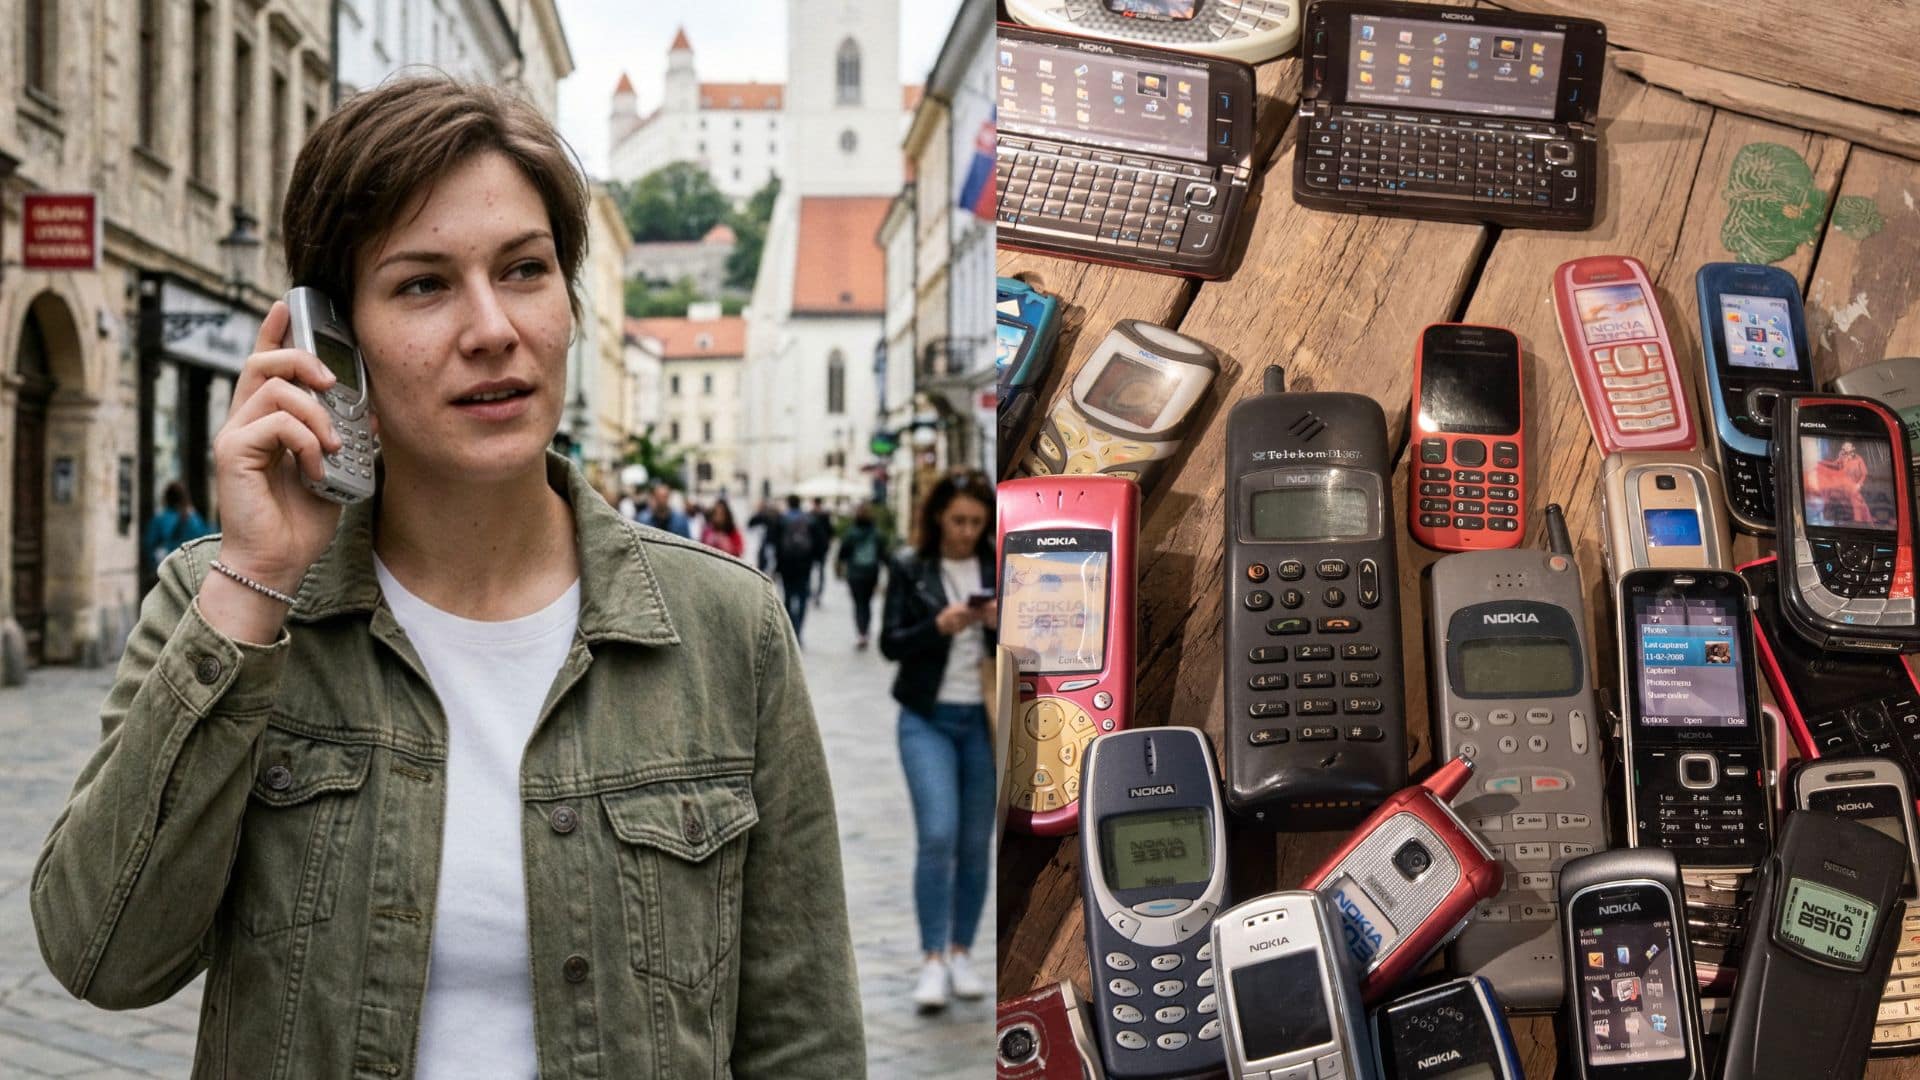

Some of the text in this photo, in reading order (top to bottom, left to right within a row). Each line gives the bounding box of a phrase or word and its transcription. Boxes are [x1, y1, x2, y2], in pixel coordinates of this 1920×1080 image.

[1442, 13, 1475, 22] NOKIA
[1078, 43, 1114, 54] NOKIA
[1590, 320, 1644, 333] NOKIA
[1425, 470, 1430, 478] 1
[1458, 472, 1465, 480] 2
[1508, 475, 1515, 483] 3
[1458, 487, 1465, 495] 5
[1508, 490, 1514, 498] 6
[1458, 503, 1464, 511] 8
[1507, 505, 1514, 513] 9
[1037, 538, 1077, 546] NOKIA
[1283, 565, 1343, 573] ABC MENU
[1254, 591, 1338, 604] C R M
[1483, 613, 1539, 624] NOKIA
[1348, 646, 1357, 655] 3
[1658, 642, 1689, 650] captured
[1259, 649, 1265, 658] 1
[1302, 647, 1311, 656] 2
[1257, 677, 1265, 685] 4
[1303, 674, 1312, 683] 5
[1350, 673, 1359, 681] 6
[1257, 704, 1267, 712] 7
[1304, 701, 1312, 710] 8
[1351, 700, 1359, 709] 9
[1642, 717, 1745, 725] Options Open Close
[1303, 728, 1312, 736] 0
[1505, 739, 1541, 748] R M
[1873, 744, 1880, 753] 2
[1131, 785, 1175, 797] NOKIA
[1837, 802, 1874, 811] NOKIA
[1517, 817, 1525, 825] 2
[1561, 816, 1569, 824] 3
[1599, 902, 1641, 915] NOKIA
[1844, 904, 1863, 917] 9:30
[1802, 901, 1853, 926] NOKIA
[1334, 890, 1382, 948] NOKIA
[1798, 911, 1850, 941] 8910
[1782, 929, 1805, 945] Menu
[1250, 937, 1290, 952] NOKIA
[1418, 1050, 1462, 1070] NOKIA
